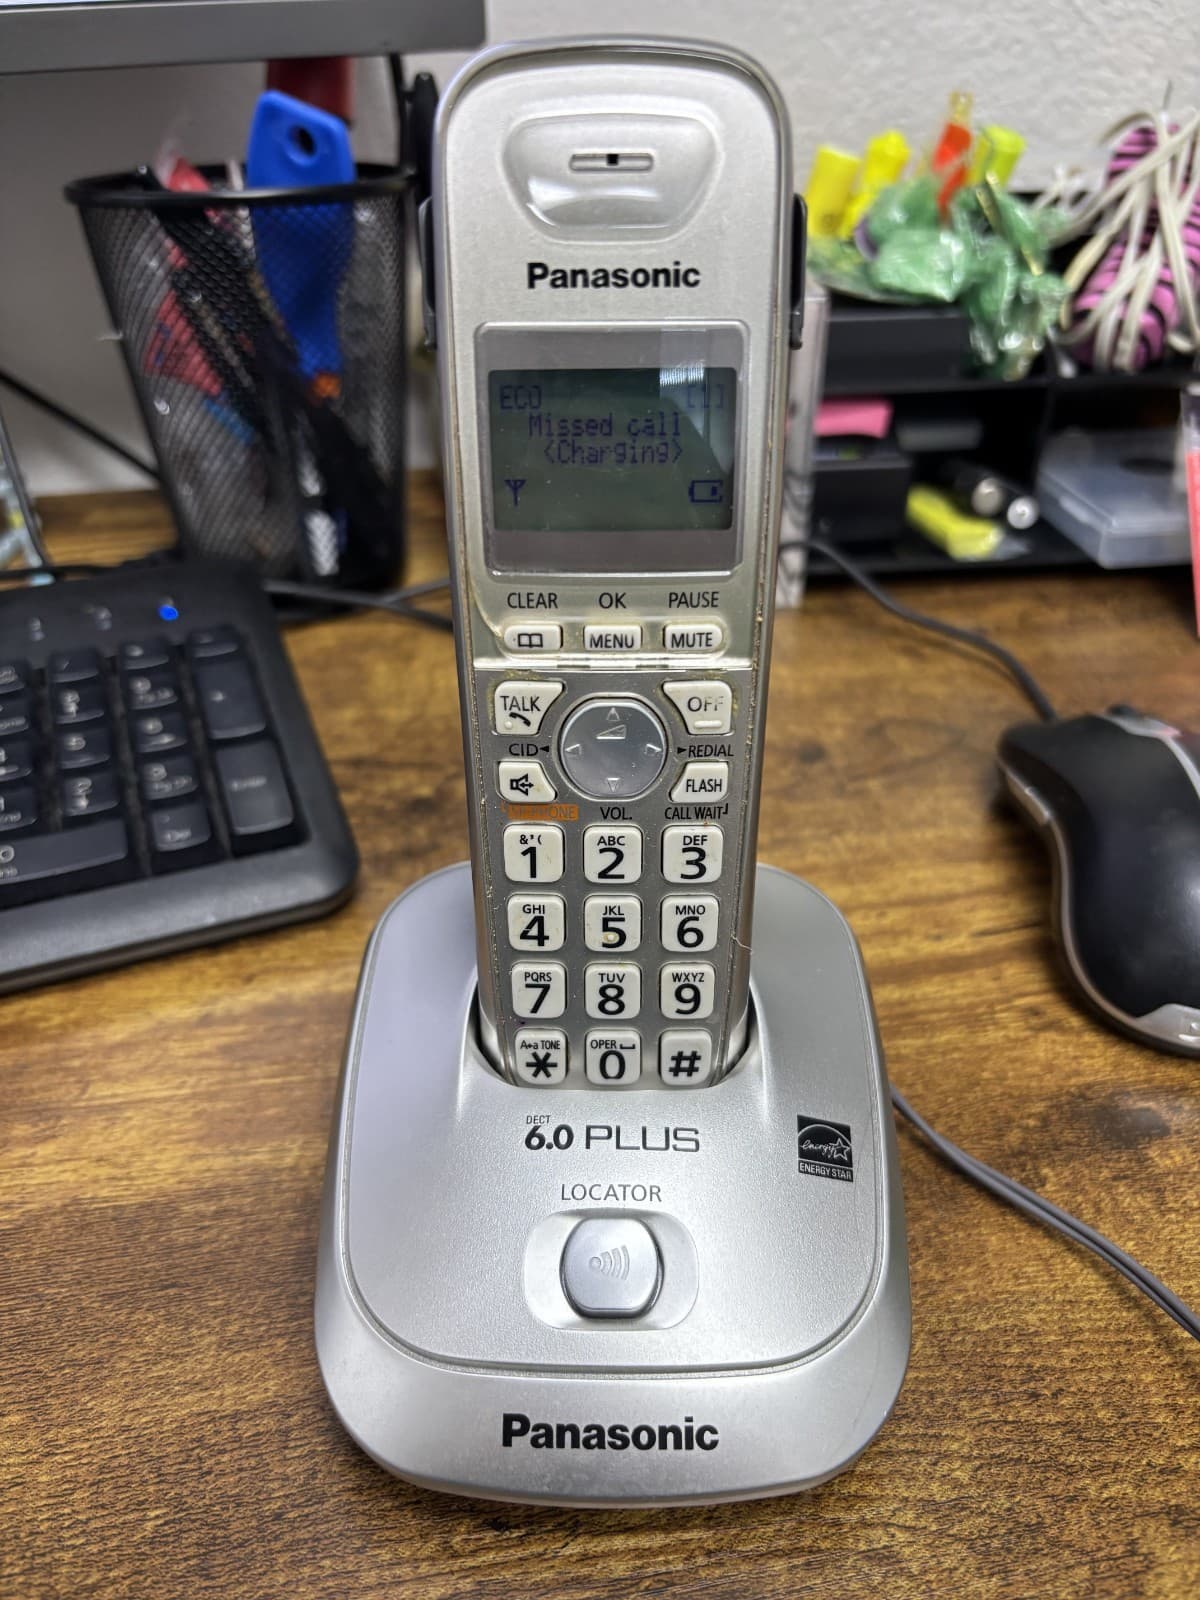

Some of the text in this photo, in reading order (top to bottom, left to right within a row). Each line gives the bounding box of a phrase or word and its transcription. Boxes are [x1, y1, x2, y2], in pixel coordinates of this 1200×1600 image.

[527, 261, 701, 289] Panasonic
[500, 385, 542, 410] ECO
[528, 411, 681, 437] Missed call
[507, 592, 558, 609] CLEAR
[598, 592, 626, 609] OK
[668, 591, 719, 609] PAUSE
[589, 634, 635, 649] MENU
[671, 632, 713, 648] MUTE
[500, 695, 541, 712] TALK
[508, 743, 539, 757] CID
[688, 744, 734, 758] REDIAL
[686, 778, 722, 793] FLASH
[600, 806, 633, 820] VOL.
[664, 806, 724, 820] CALL WAIT
[597, 835, 626, 847] ABC
[682, 834, 708, 846] DEF
[520, 846, 537, 879] 1
[597, 847, 625, 880] 2
[680, 847, 707, 880] 3
[522, 903, 546, 915] GHI
[602, 905, 625, 917] JKL
[675, 904, 706, 916] MNO
[519, 915, 549, 947] 4
[601, 916, 627, 949] 5
[676, 915, 704, 948] 6
[524, 971, 552, 983] PQRS
[598, 973, 626, 984] TUV
[671, 972, 705, 983] WXYZ
[524, 983, 551, 1014] 7
[597, 983, 626, 1016] 8
[674, 983, 701, 1015] 9
[540, 1039, 560, 1050] TONE
[590, 1039, 617, 1050] OPER
[599, 1050, 626, 1080] 0
[668, 1050, 702, 1078] #
[526, 1115, 551, 1125] DECT
[524, 1124, 700, 1153] 6.0 PLUS
[799, 1162, 852, 1181] ENERGY STAR
[561, 1183, 662, 1202] LOCATOR
[502, 1412, 719, 1451] Panasonic
